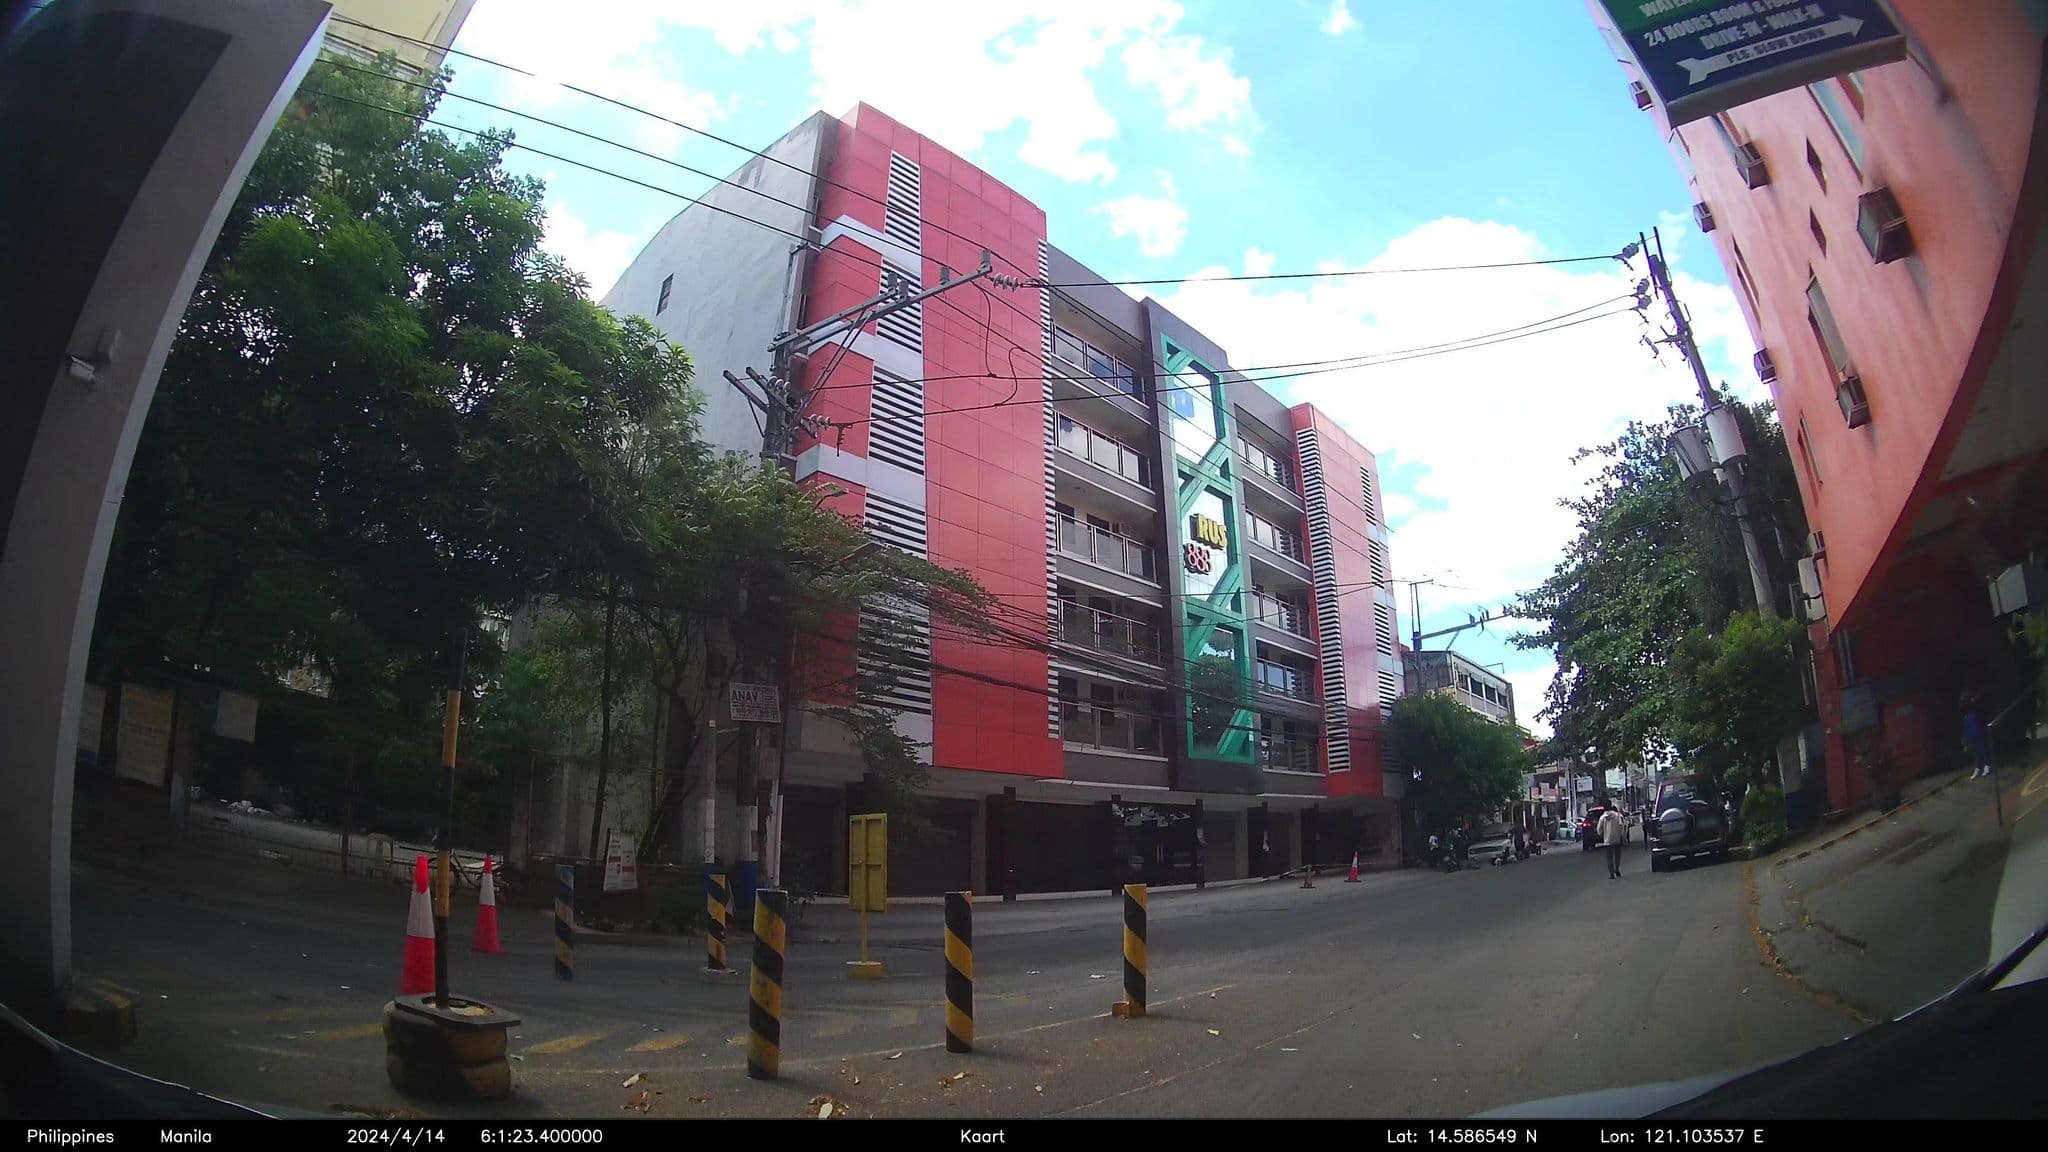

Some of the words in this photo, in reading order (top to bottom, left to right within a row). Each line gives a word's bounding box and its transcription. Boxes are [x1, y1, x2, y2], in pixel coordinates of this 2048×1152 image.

[1643, 29, 1666, 47] 24
[1662, 14, 1713, 41] HOURS
[1699, 20, 1762, 50] DRIVE-IN
[1765, 3, 1825, 30] WALK-IN
[1753, 37, 1788, 56] SLOW
[1788, 27, 1825, 45] DOWN
